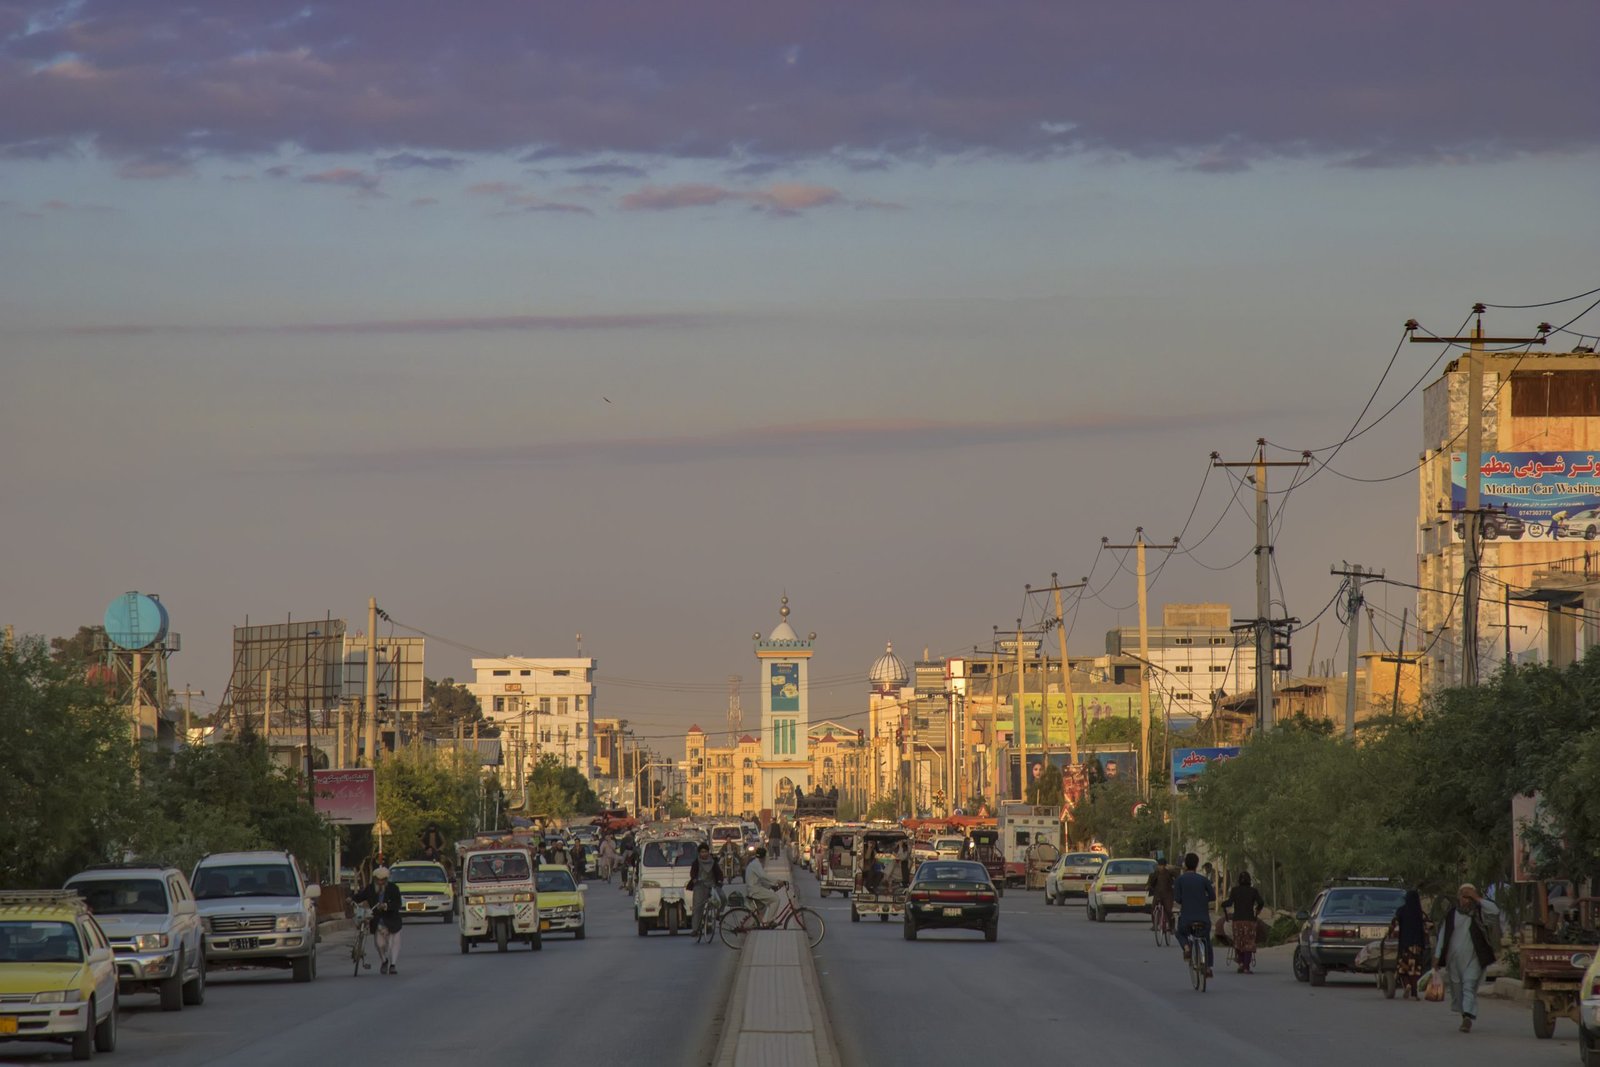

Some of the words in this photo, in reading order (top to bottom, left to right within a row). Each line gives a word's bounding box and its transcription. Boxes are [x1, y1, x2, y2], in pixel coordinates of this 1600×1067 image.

[1464, 455, 1512, 478] مطه
[1484, 483, 1531, 495] Motahar
[1532, 482, 1553, 495] Car
[1555, 482, 1600, 496] Washing
